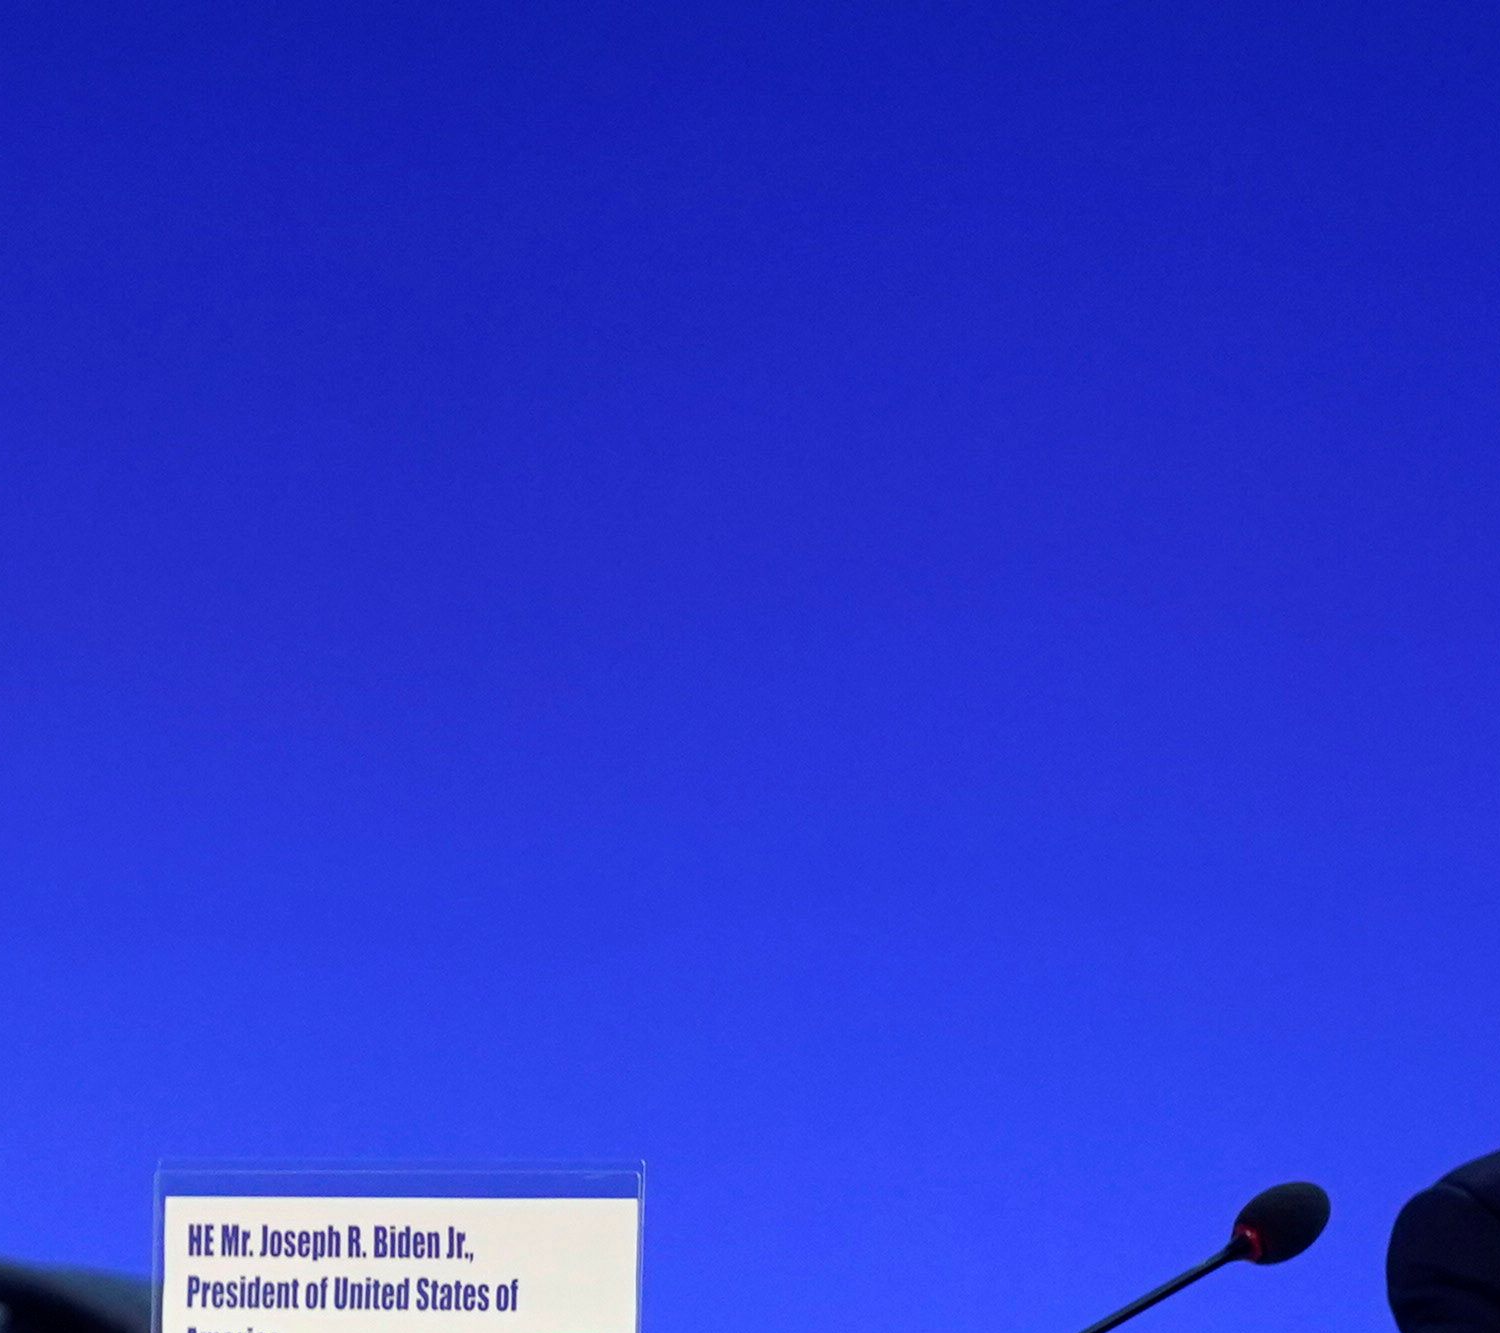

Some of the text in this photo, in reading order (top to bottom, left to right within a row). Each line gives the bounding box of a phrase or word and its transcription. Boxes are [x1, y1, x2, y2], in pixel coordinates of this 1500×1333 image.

[189, 1224, 474, 1261] HE Mr. Joseph R. Biden Jr.,
[187, 1276, 518, 1312] President of United States of
